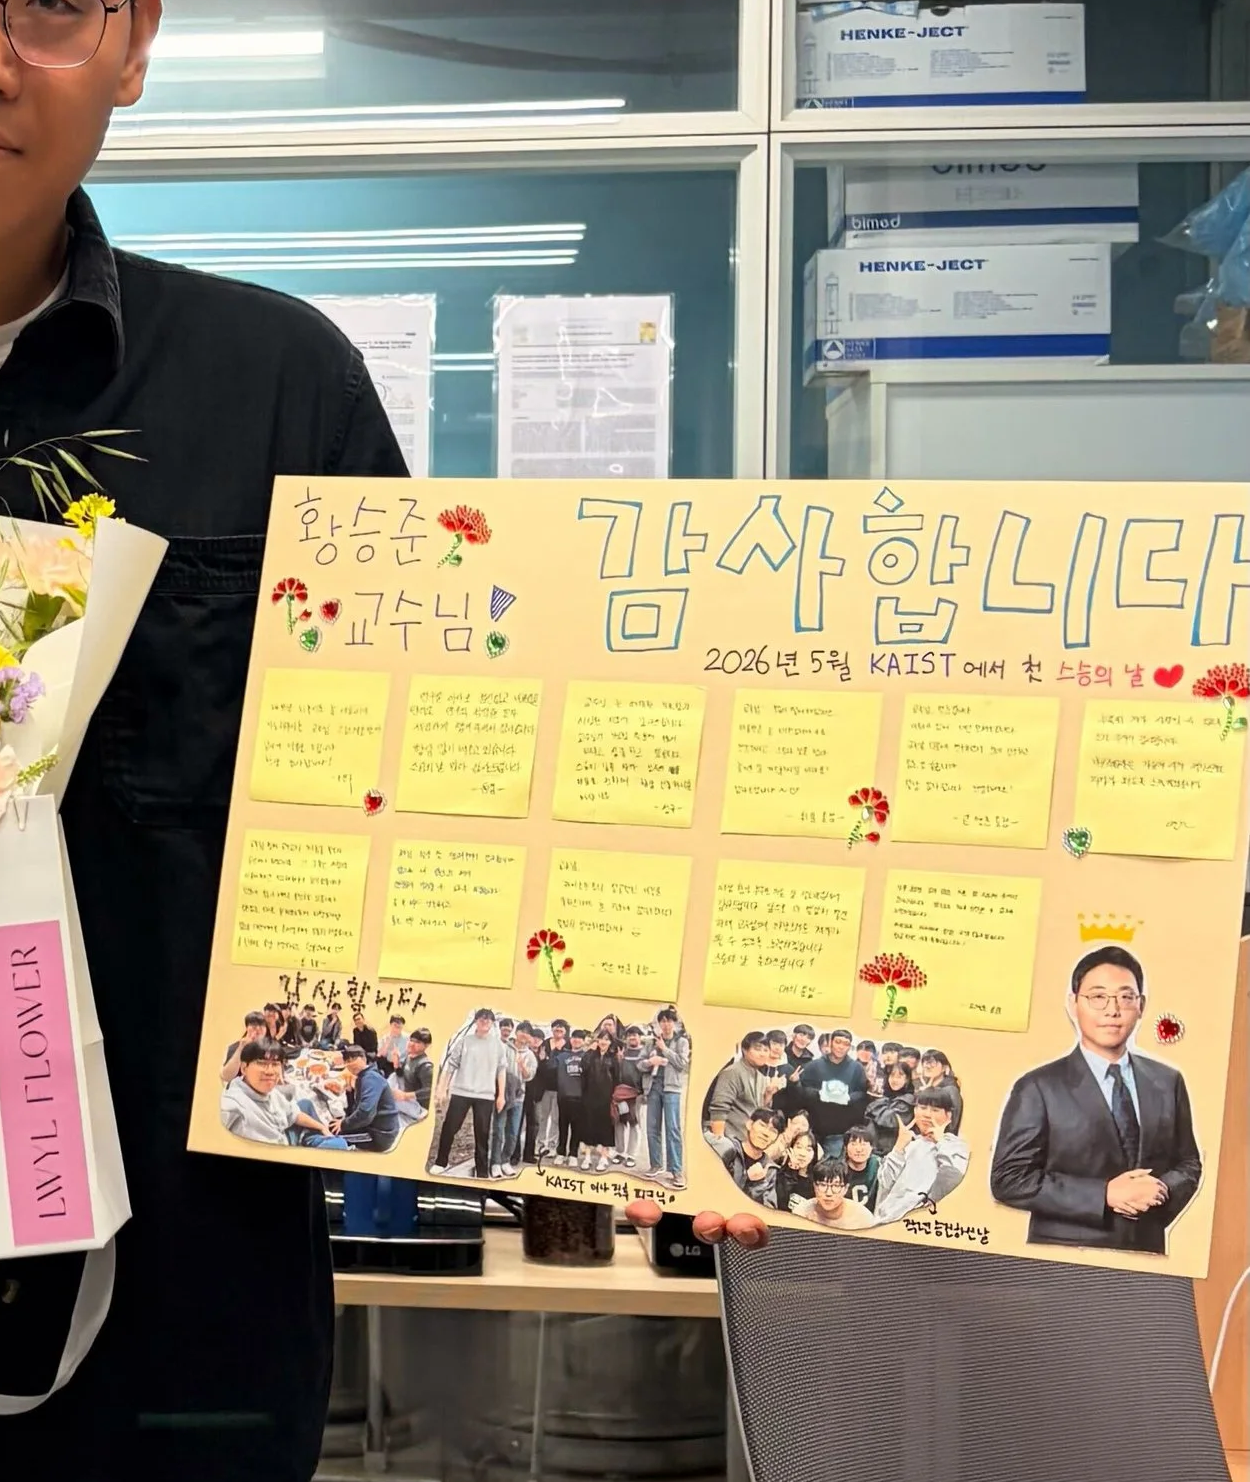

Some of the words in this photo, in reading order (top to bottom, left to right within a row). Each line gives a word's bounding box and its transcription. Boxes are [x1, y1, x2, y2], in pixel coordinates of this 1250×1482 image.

[858, 258, 985, 273] HENKE-JECT
[294, 486, 428, 566] 황승준
[576, 486, 1250, 653] 감사합니다
[703, 644, 800, 675] 2026년
[810, 650, 852, 682] 5월
[1021, 653, 1044, 684] 첫
[1055, 660, 1113, 687] 스승의
[1124, 663, 1146, 688] 날
[278, 971, 427, 1016] 감사합니다
[10, 945, 54, 1104] FLOWER
[30, 1118, 67, 1219] LWYL
[545, 1175, 586, 1194] KAIST
[685, 1245, 702, 1256] LG
